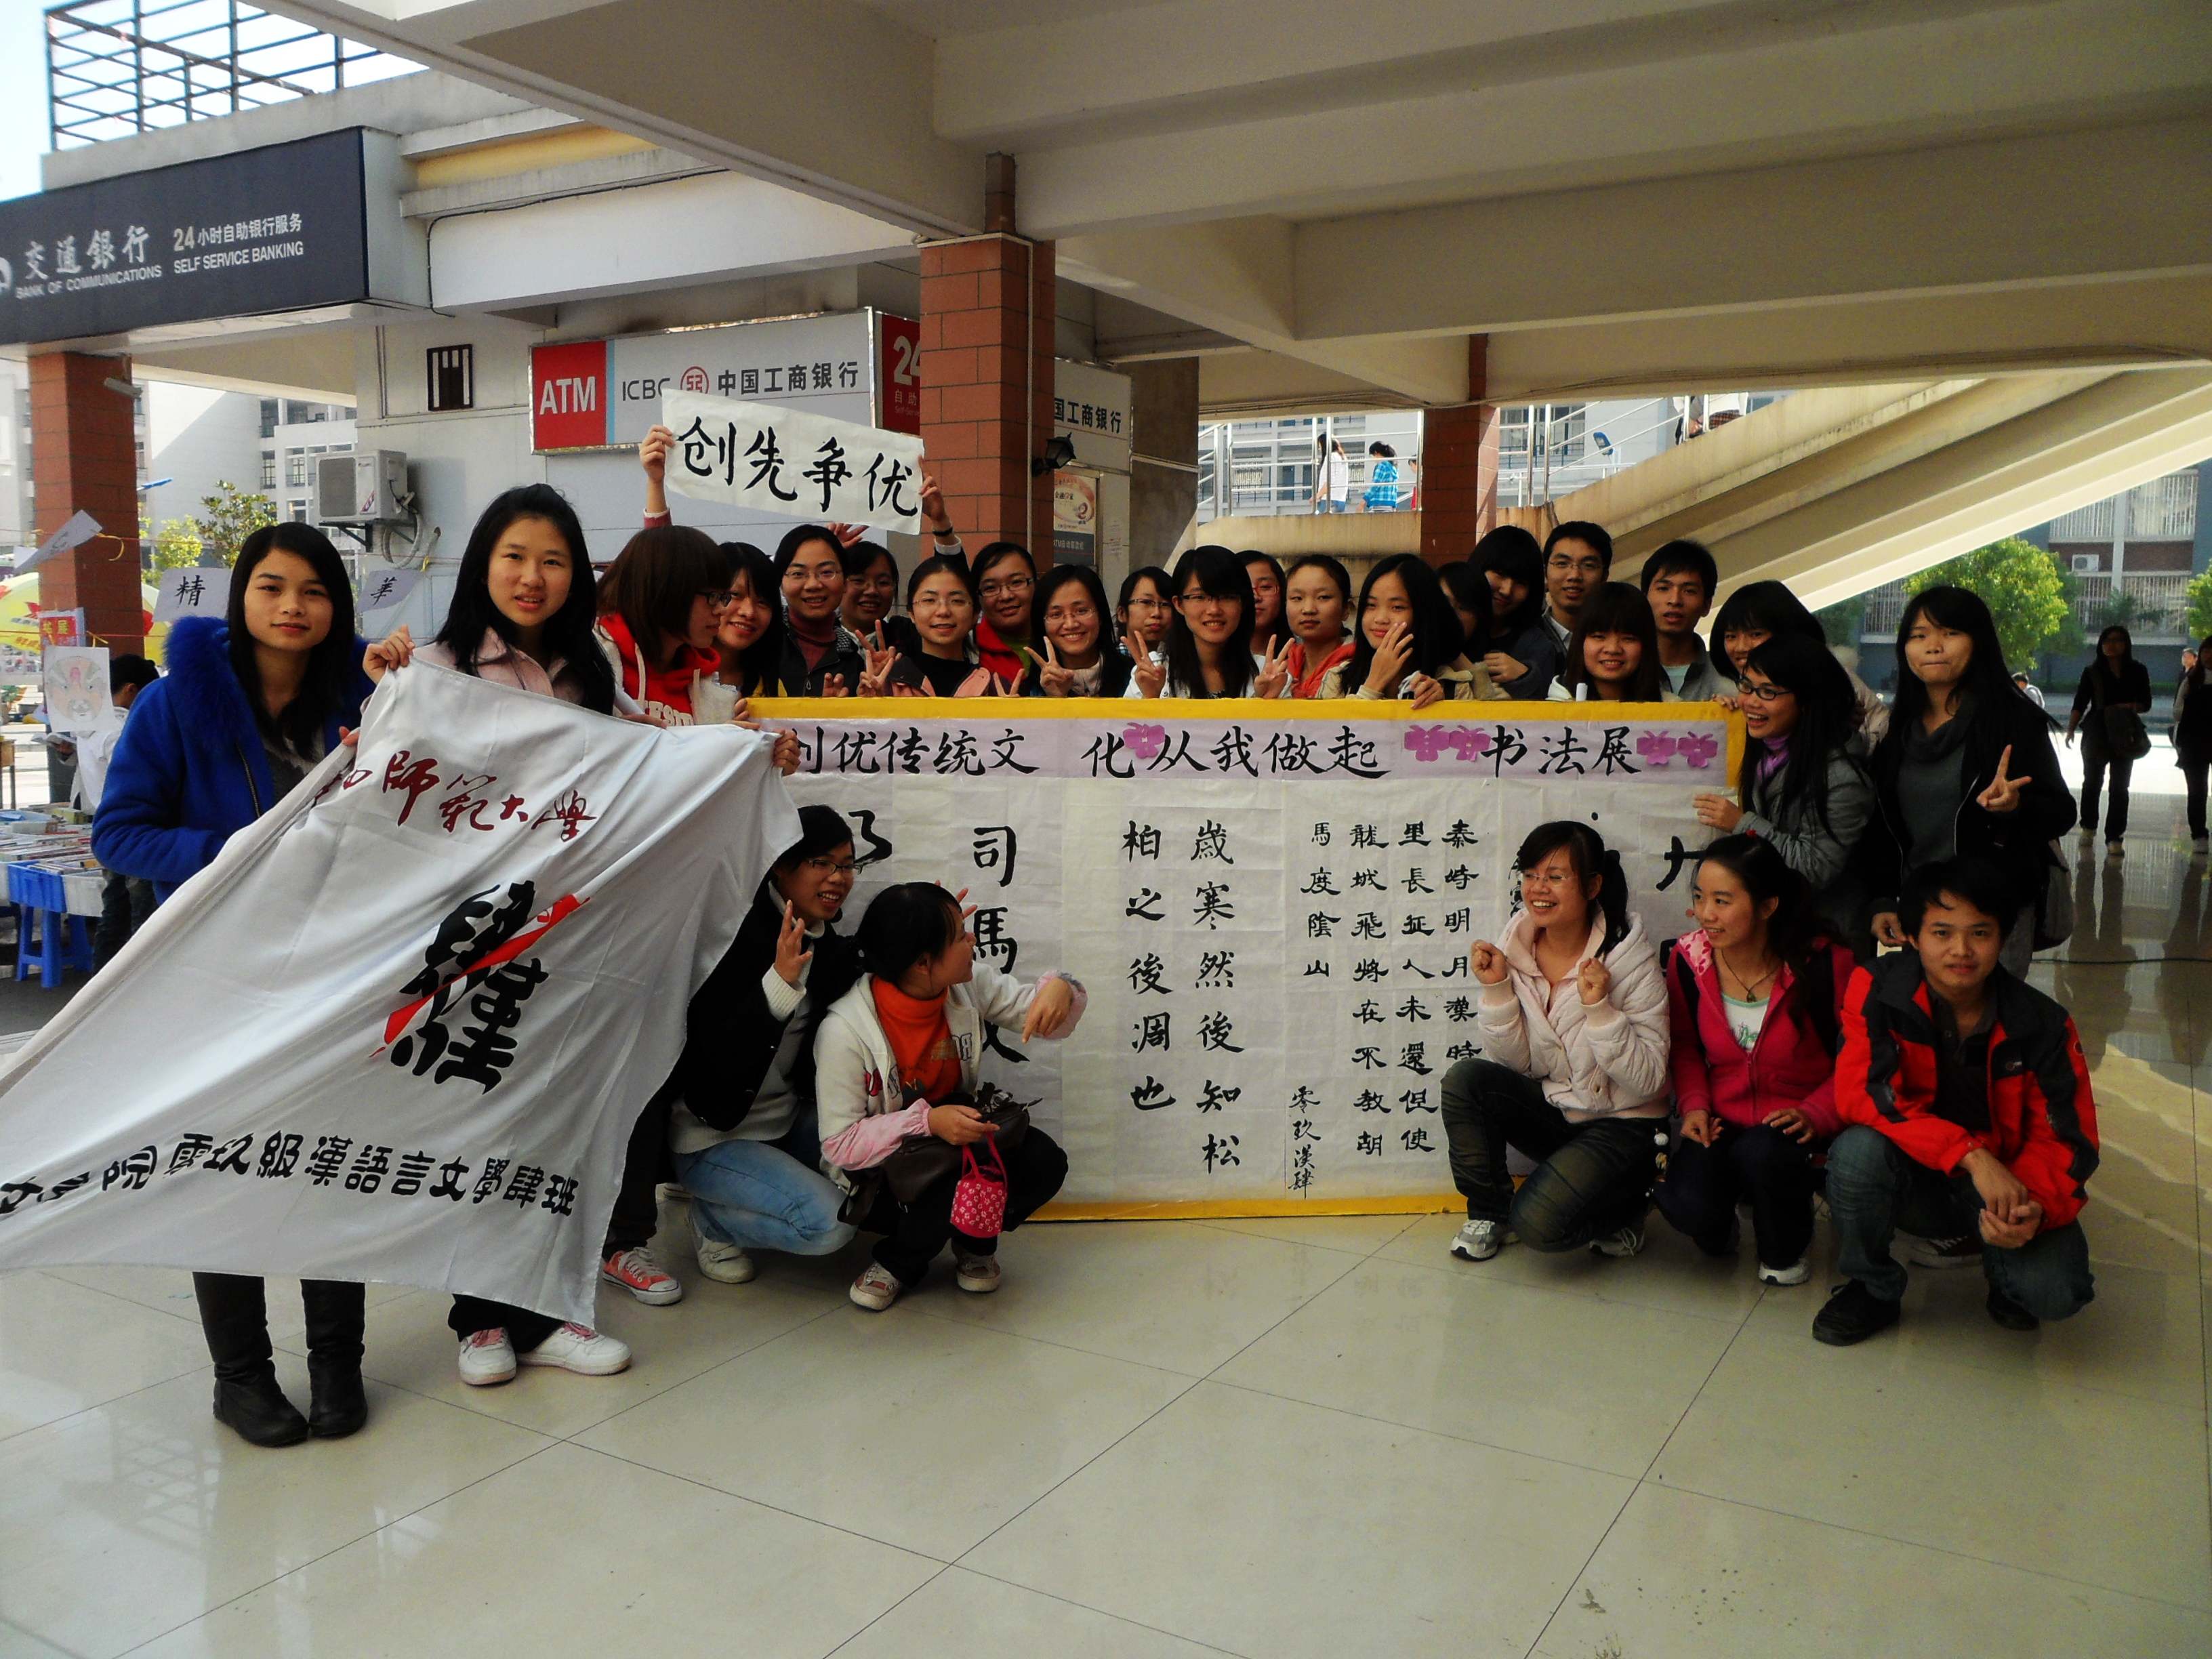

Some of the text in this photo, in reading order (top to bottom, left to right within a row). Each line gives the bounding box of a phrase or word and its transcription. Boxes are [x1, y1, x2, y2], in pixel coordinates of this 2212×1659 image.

[174, 241, 304, 274] SELF SERVICE BANKING
[47, 281, 62, 293] OF
[66, 265, 163, 291] COMMUNICATIONS
[539, 375, 596, 415] ATM
[622, 377, 671, 401] ICBC
[718, 361, 859, 396] 中国工商银行
[895, 388, 916, 406] 自助
[676, 415, 918, 516] 创先争优
[174, 575, 205, 609] 精
[1481, 723, 1641, 779] 书法展
